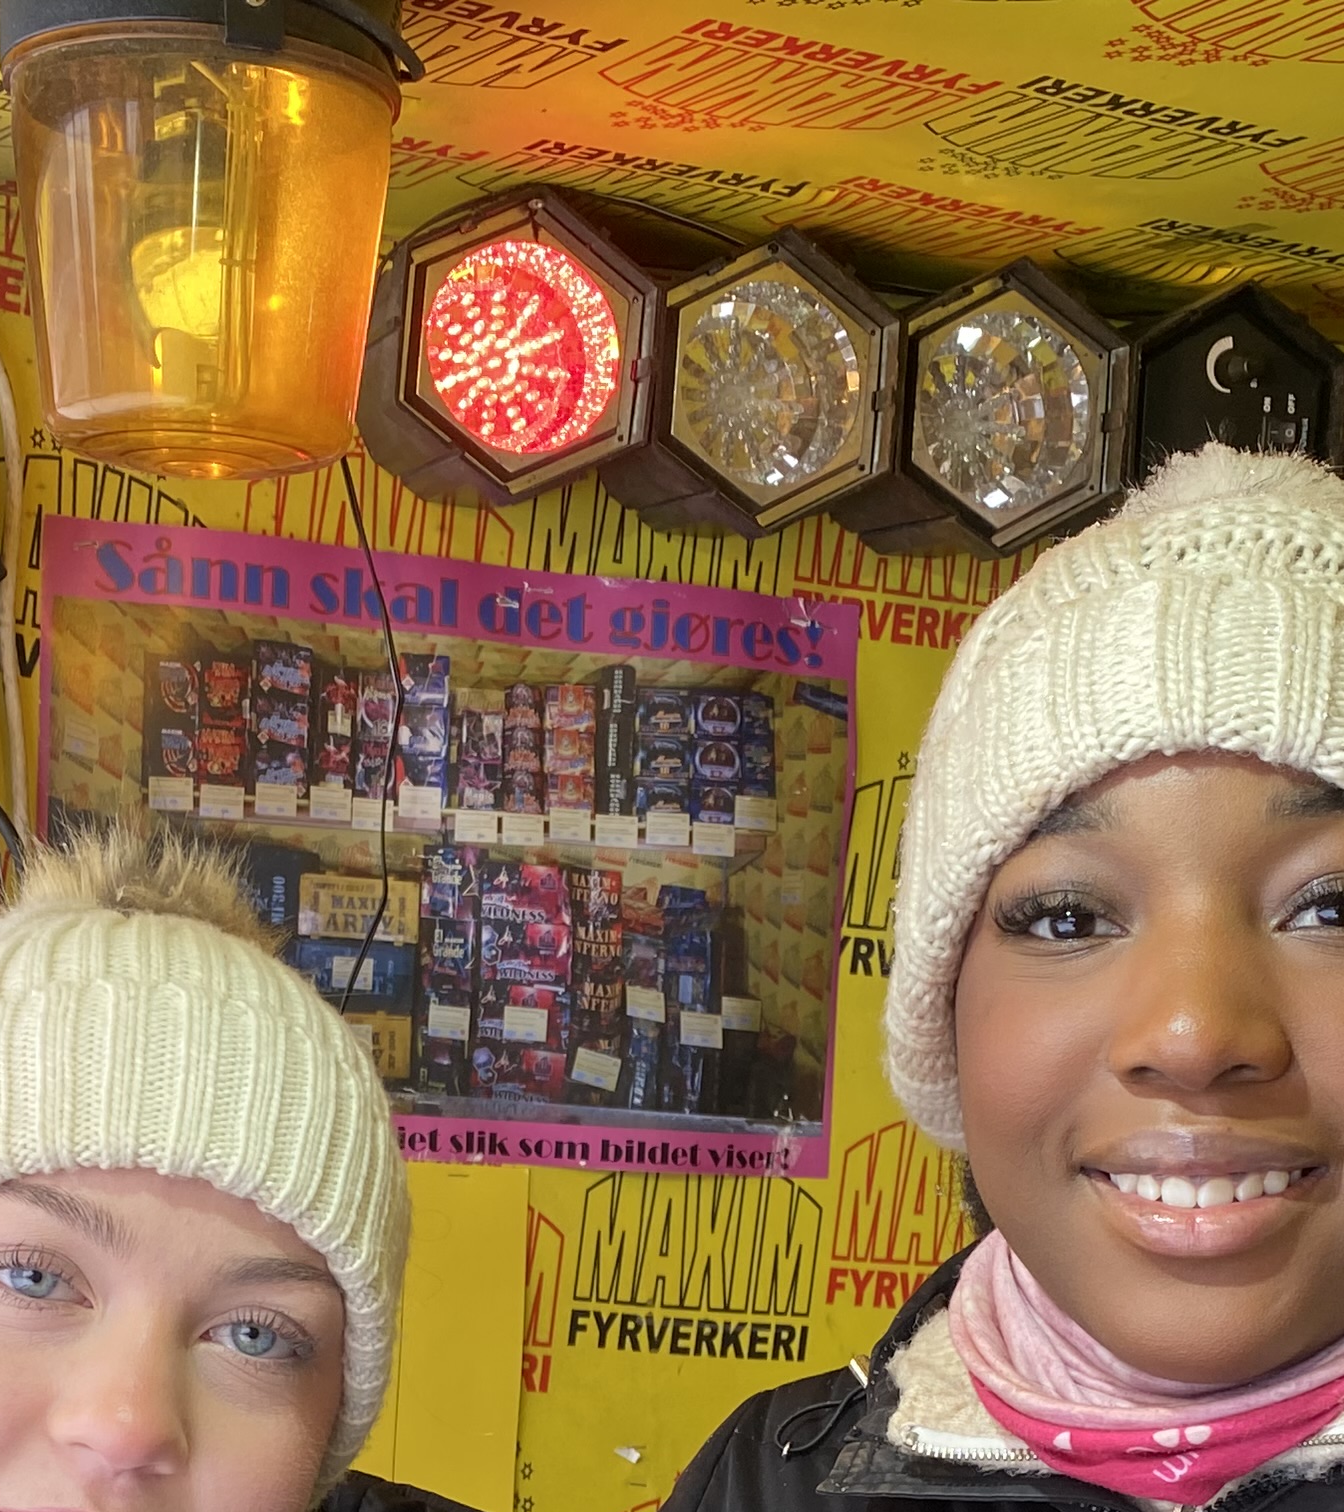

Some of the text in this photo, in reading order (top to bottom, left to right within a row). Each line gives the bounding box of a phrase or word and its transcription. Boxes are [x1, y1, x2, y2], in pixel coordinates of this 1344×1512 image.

[681, 18, 1005, 95] FYRVERKERI
[1018, 75, 1308, 148] FYRVERKERI
[522, 139, 811, 198] FYRVERKERI
[94, 537, 290, 609] Sånn
[307, 562, 459, 632] skal
[478, 584, 594, 644] det
[609, 597, 824, 671] gjøres!
[449, 1130, 511, 1158] slik
[517, 1136, 591, 1163] som
[599, 1138, 703, 1168] bildet
[573, 1171, 824, 1318] MAXIM
[567, 1309, 810, 1363] FYRVERKERI
